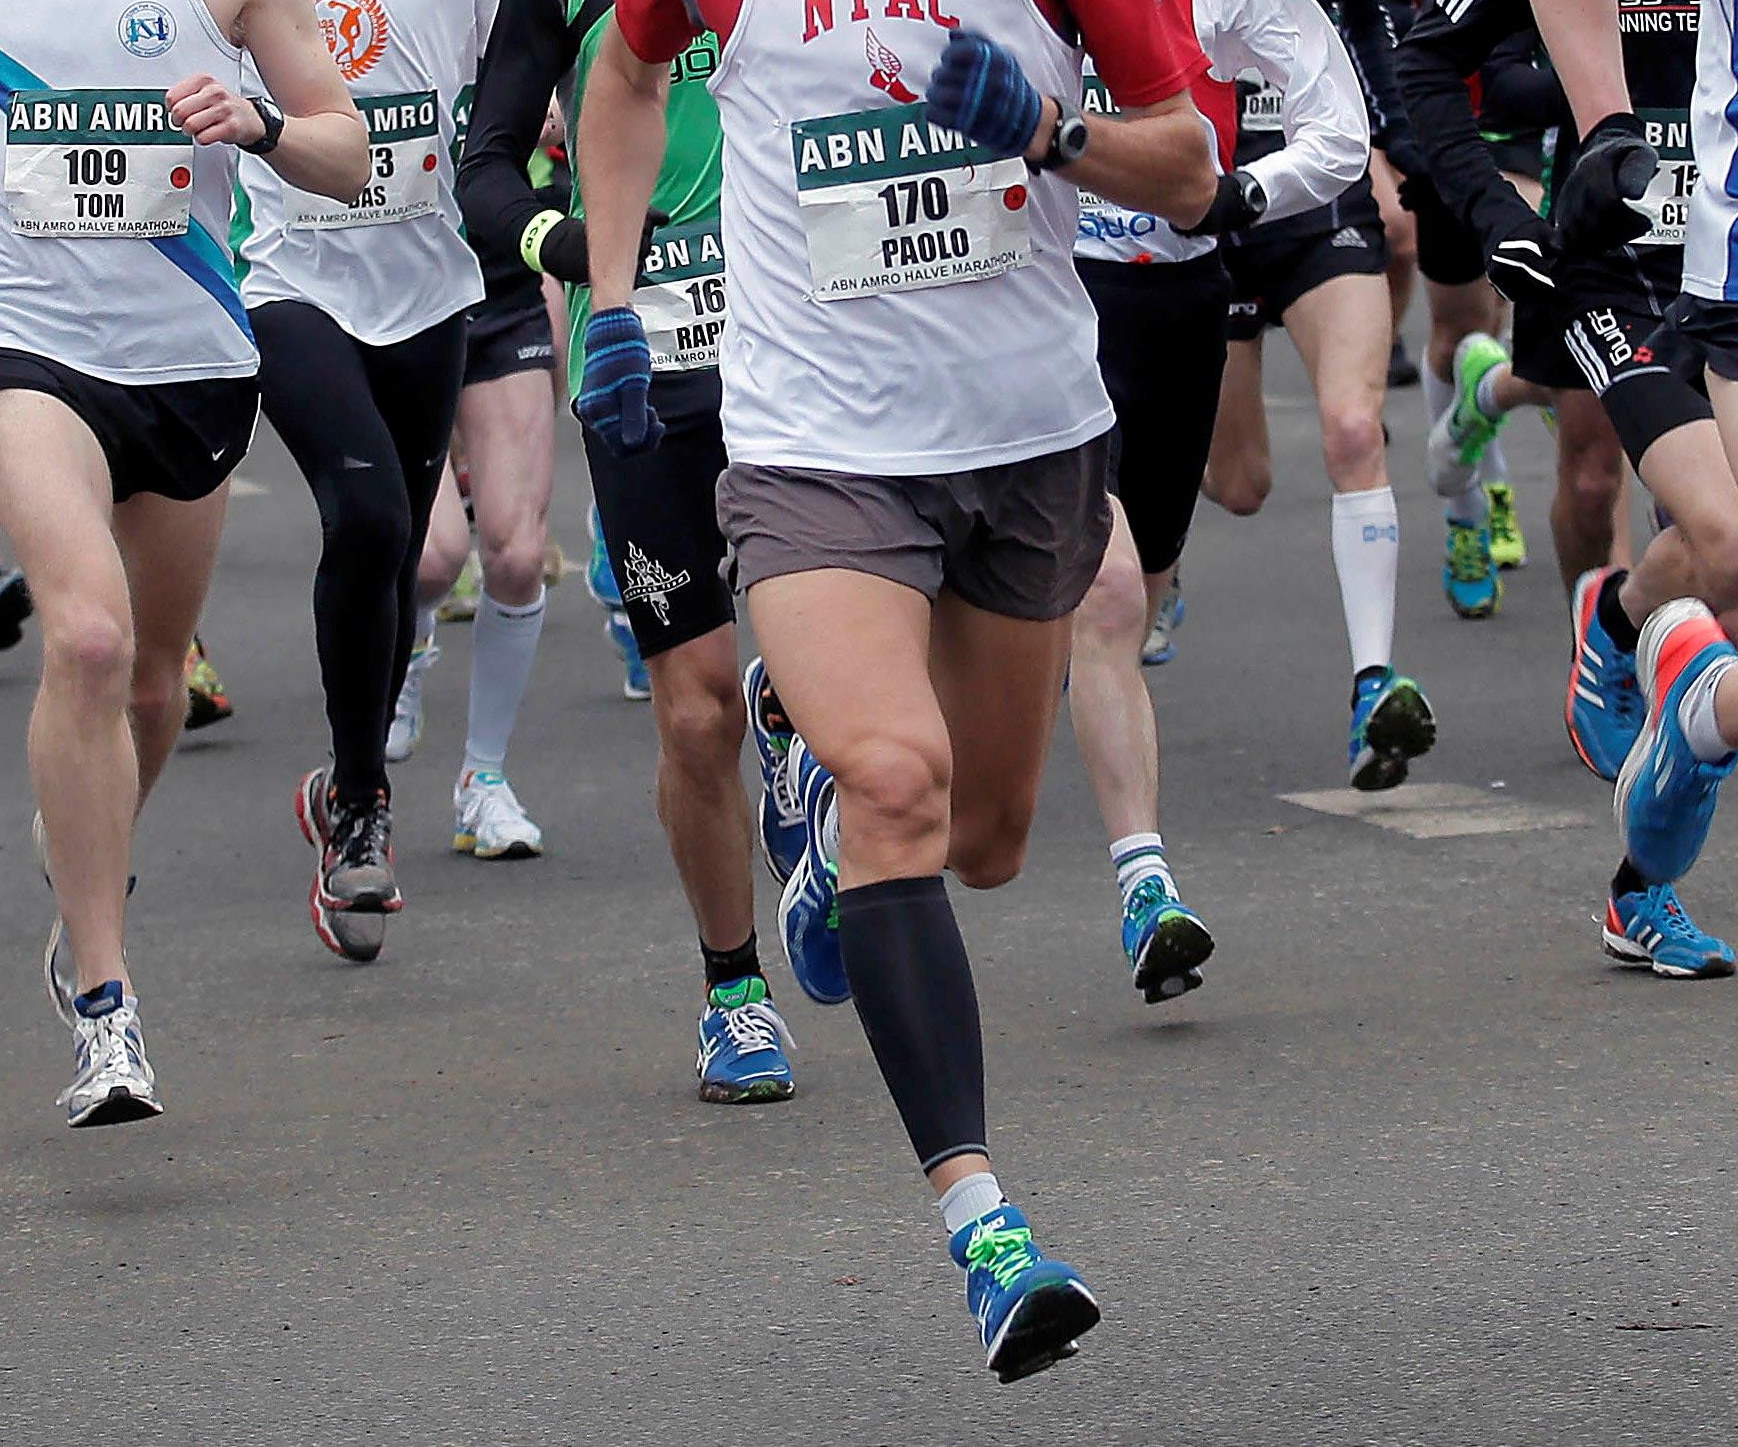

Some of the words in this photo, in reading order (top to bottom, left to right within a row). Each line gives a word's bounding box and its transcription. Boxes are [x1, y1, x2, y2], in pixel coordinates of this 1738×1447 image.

[9, 102, 80, 132] ABN
[1644, 120, 1688, 149] BN
[799, 128, 886, 176] ABN
[899, 121, 979, 160] AM
[63, 148, 128, 186] 109
[73, 193, 124, 218] TOM
[297, 212, 318, 224] ABN
[319, 211, 348, 223] AMRO
[350, 209, 381, 221] HALVE
[877, 176, 951, 229] 170
[20, 220, 40, 232] ABN
[41, 220, 76, 232] AMRO
[78, 220, 115, 231] HALVE
[117, 220, 176, 232] MARATHON
[644, 237, 690, 274] BN
[881, 226, 971, 271] PAOLO
[829, 277, 859, 293] ABN
[860, 272, 903, 290] AMRO
[904, 266, 950, 285] HALVE
[952, 249, 1019, 276] MARATHON
[685, 276, 726, 317] 16
[676, 319, 726, 352] RAP
[673, 350, 706, 364] AMRO
